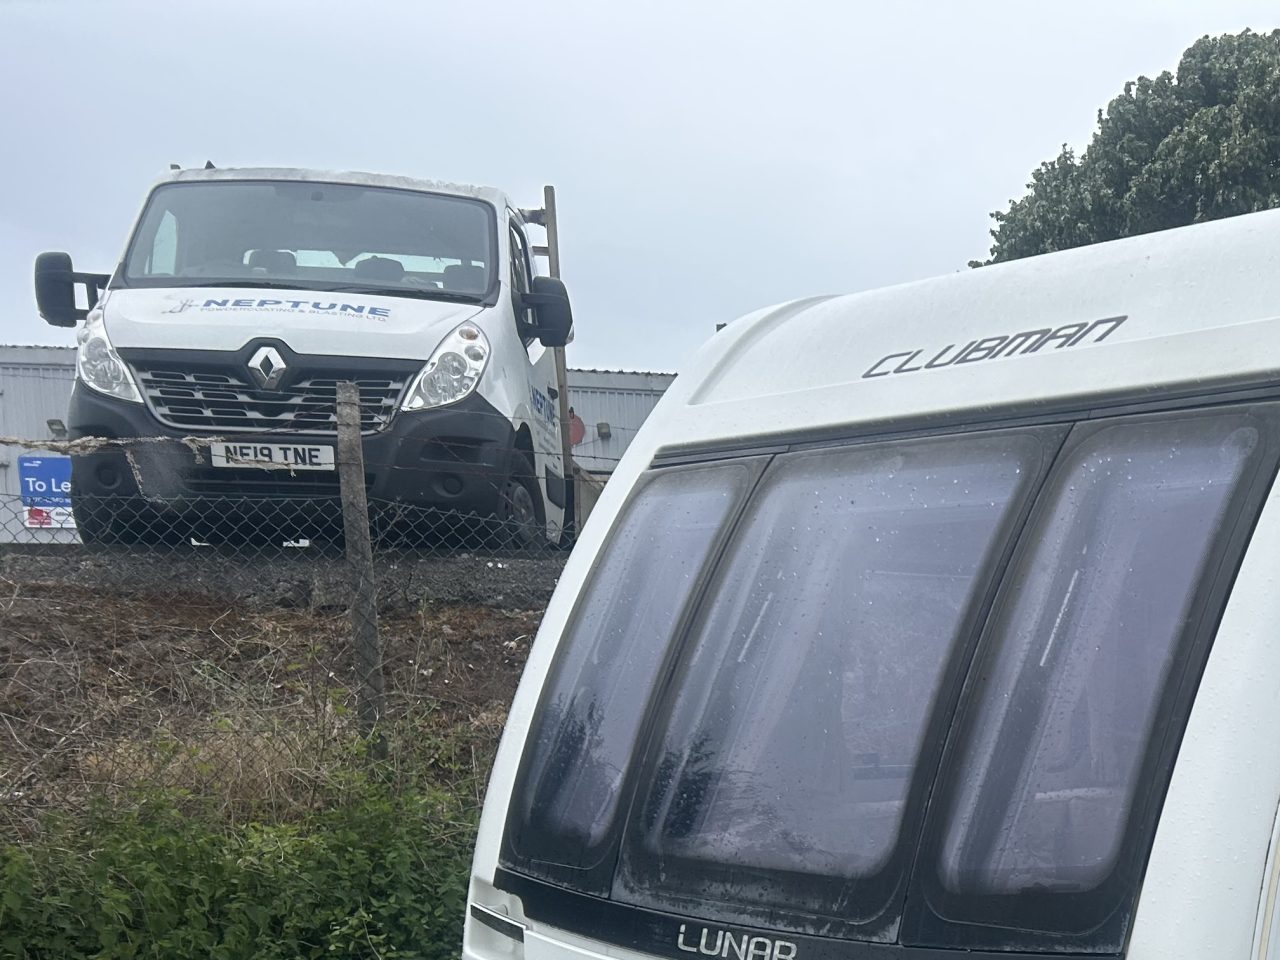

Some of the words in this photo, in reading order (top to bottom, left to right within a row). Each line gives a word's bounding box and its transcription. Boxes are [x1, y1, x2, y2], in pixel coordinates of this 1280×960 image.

[202, 299, 391, 317] NEPTUNE
[308, 309, 363, 319] BLASTING
[861, 315, 1129, 379] CLUBMAN
[279, 446, 322, 467] TNE
[24, 477, 47, 493] To
